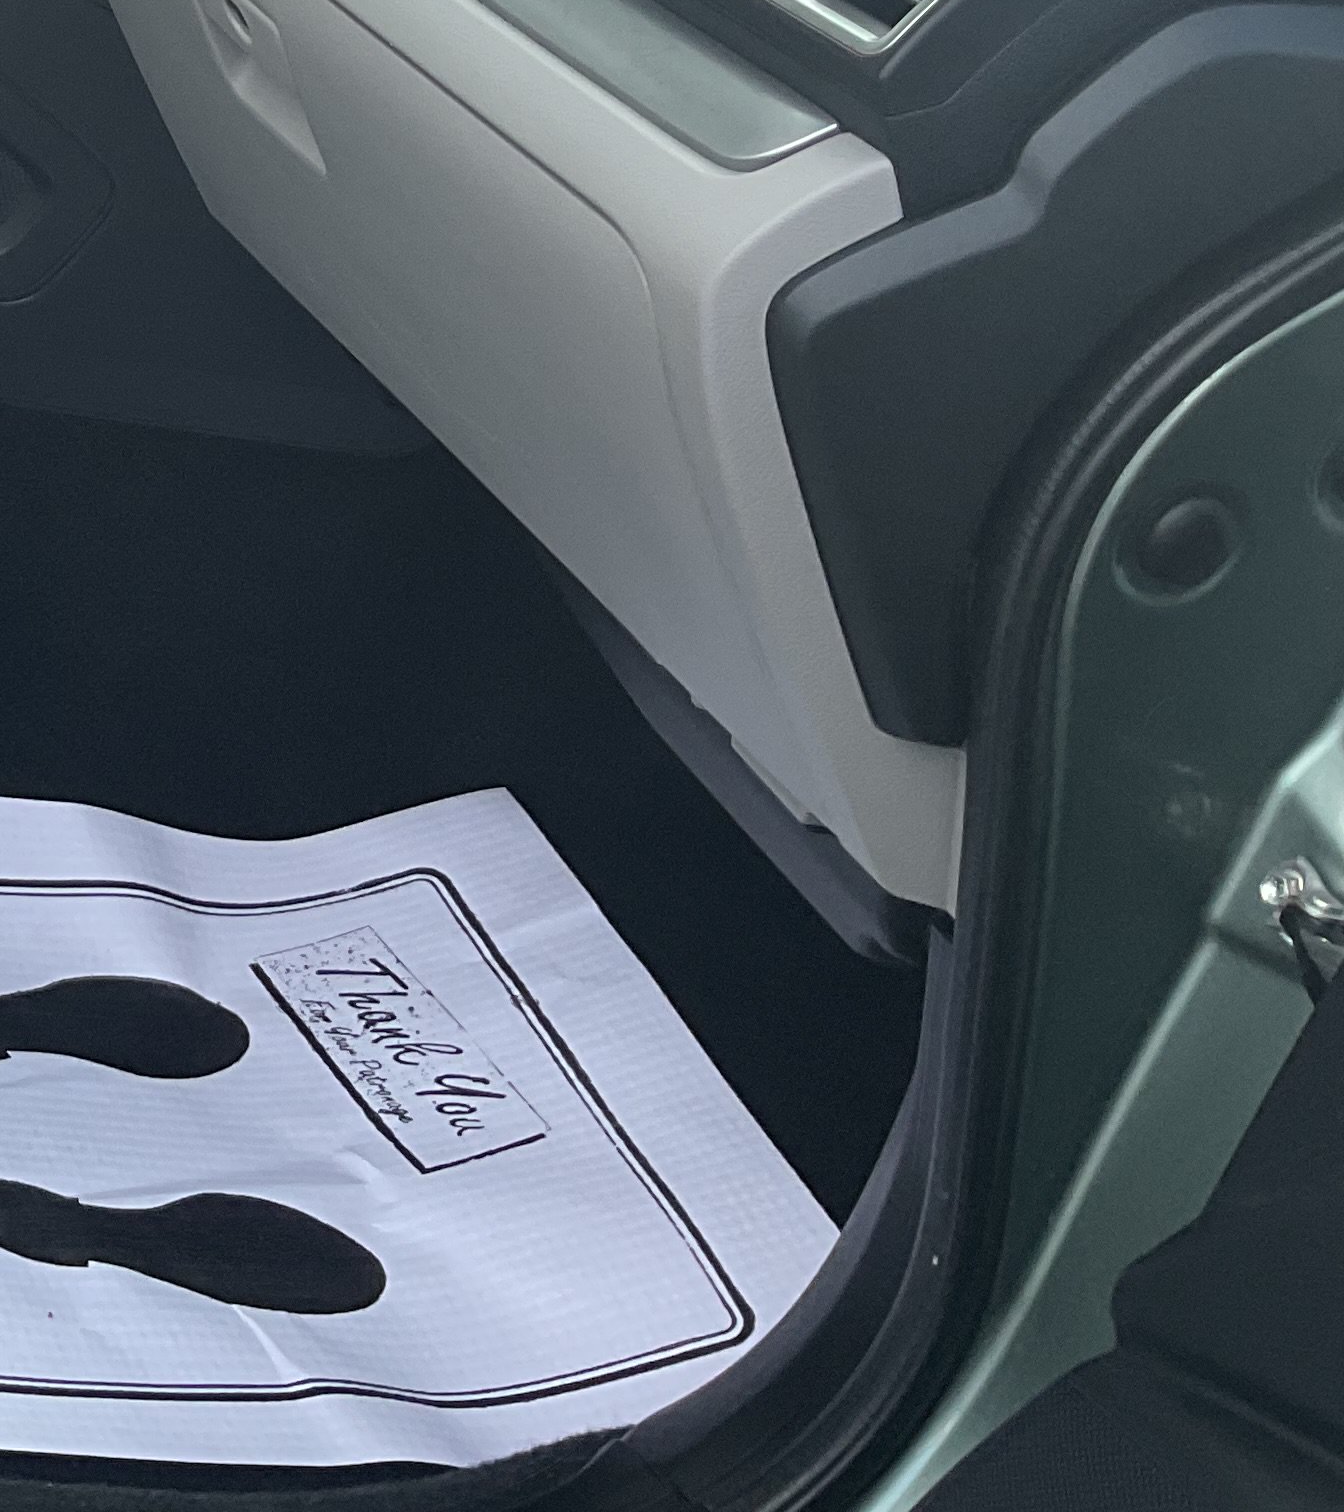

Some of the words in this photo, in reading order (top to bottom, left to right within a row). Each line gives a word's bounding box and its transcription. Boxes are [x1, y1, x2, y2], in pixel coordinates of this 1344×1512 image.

[315, 958, 464, 1067] Thank
[415, 1074, 508, 1137] You
[349, 1059, 414, 1124] Patronage
